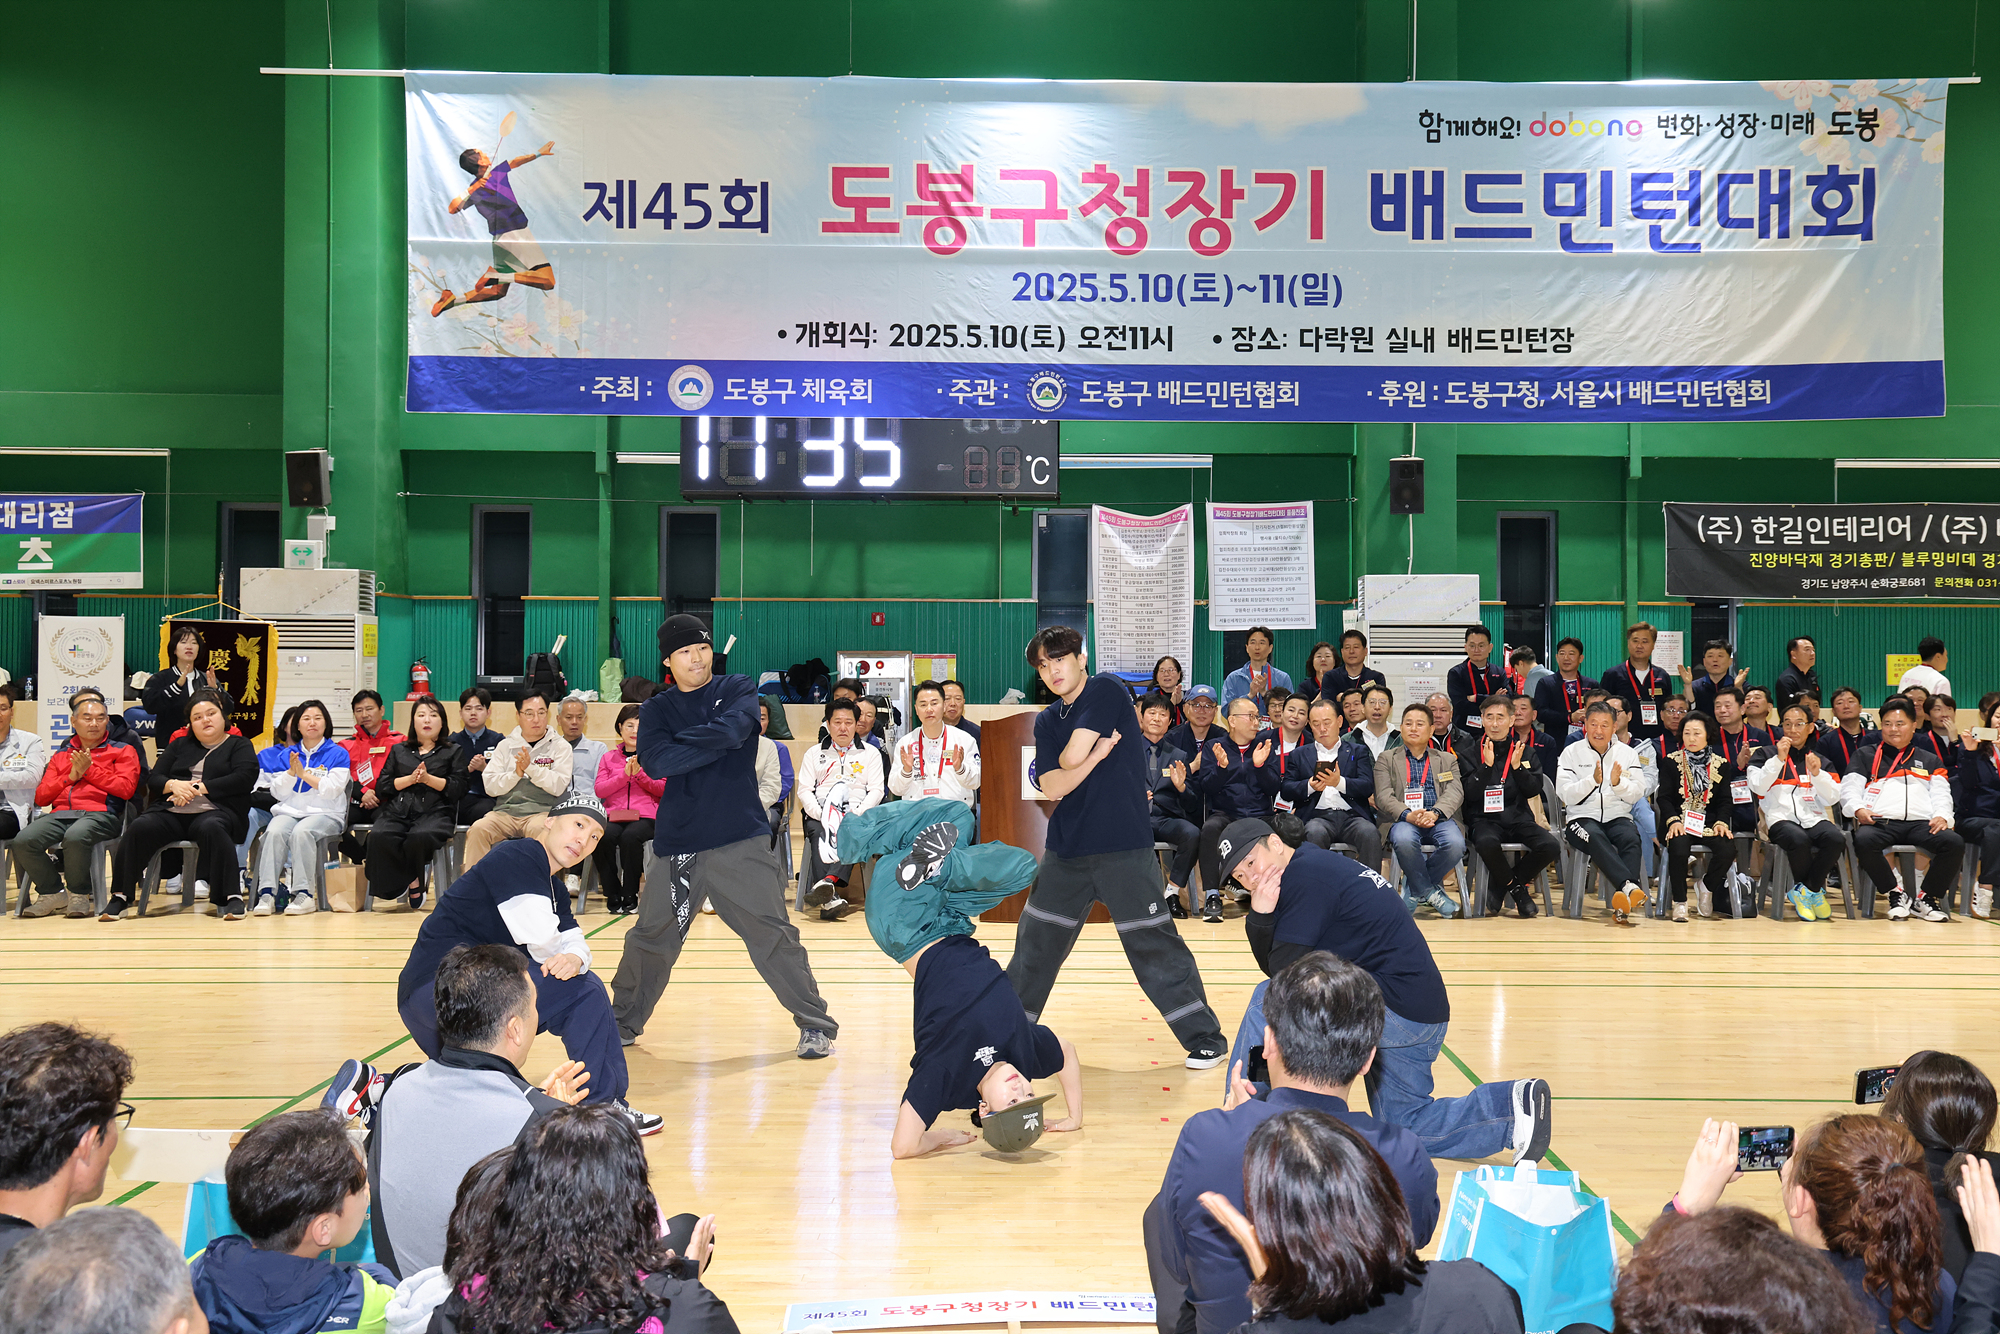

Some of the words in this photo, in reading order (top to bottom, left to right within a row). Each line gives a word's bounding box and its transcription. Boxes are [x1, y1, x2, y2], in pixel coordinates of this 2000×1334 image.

[1419, 109, 1520, 143] 함께해요!
[1530, 110, 1643, 138] dobong
[1828, 108, 1879, 142] 도봉
[583, 179, 768, 233] 제45회
[822, 164, 1323, 256] 도봉구청장기
[1371, 165, 1875, 253] 배드민턴대회
[1012, 272, 1342, 308] 2025.5.10(토)~11(일)
[796, 321, 877, 348] 개회식:
[889, 324, 1065, 352] 2025.5.10(토)
[1078, 325, 1172, 352] 오전11시
[1232, 326, 1287, 352] 장소:
[1300, 327, 1373, 353] 다락원
[1386, 327, 1434, 353] 실내
[1448, 327, 1574, 353] 배드민턴장
[724, 379, 796, 405] 도봉구
[802, 379, 871, 405] 체육회
[1080, 381, 1151, 408] 도봉구
[1158, 381, 1298, 408] 배드민턴협회
[1445, 381, 1544, 408] 도봉구청,
[1551, 381, 1621, 408] 서울시
[1629, 380, 1770, 407] 배드민턴협회
[1698, 515, 1742, 544] (주)
[1751, 515, 1911, 544] 한길인테리어
[1942, 515, 1987, 544] (주)
[18, 537, 53, 570] 츠
[1750, 553, 1822, 568] 진양바닥재
[1901, 552, 1975, 567] 블루밍비데
[1802, 579, 1829, 589] 경기도
[1832, 579, 1867, 589] 남양주시
[1871, 578, 1925, 588] 순화궁로681
[1935, 577, 1973, 587] 문의전화
[62, 686, 79, 694] 2회
[1022, 1111, 1039, 1120] adidas
[803, 1308, 868, 1321] 제45회
[879, 1300, 1038, 1316] 도봉구청장기
[1049, 1299, 1155, 1313] 배드민턴
